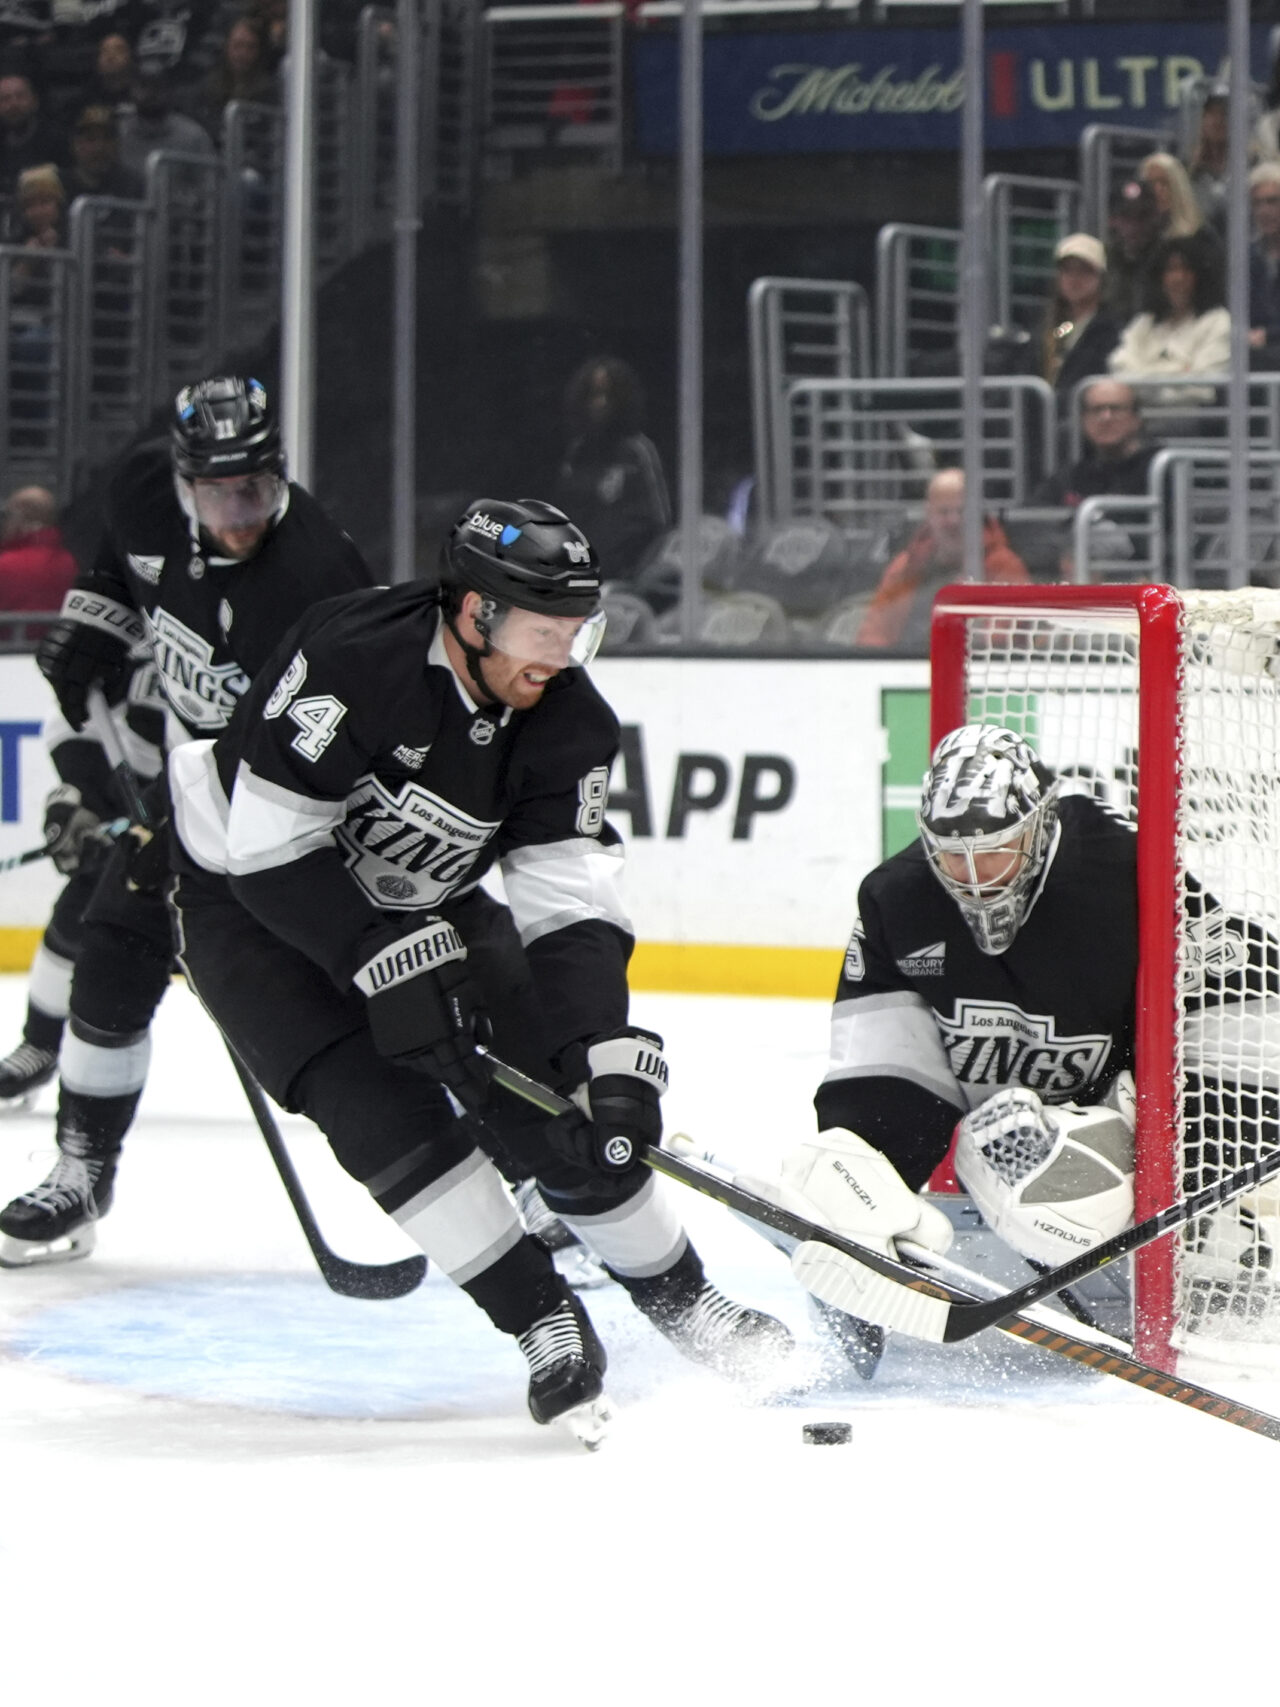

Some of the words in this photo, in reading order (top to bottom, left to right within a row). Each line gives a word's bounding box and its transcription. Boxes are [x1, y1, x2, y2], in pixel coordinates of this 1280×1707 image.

[471, 511, 504, 535] blue
[263, 649, 348, 763] 84
[410, 803, 434, 822] Los
[433, 816, 482, 842] Angeles
[972, 1015, 993, 1026] Los
[996, 1016, 1040, 1039] Angeles
